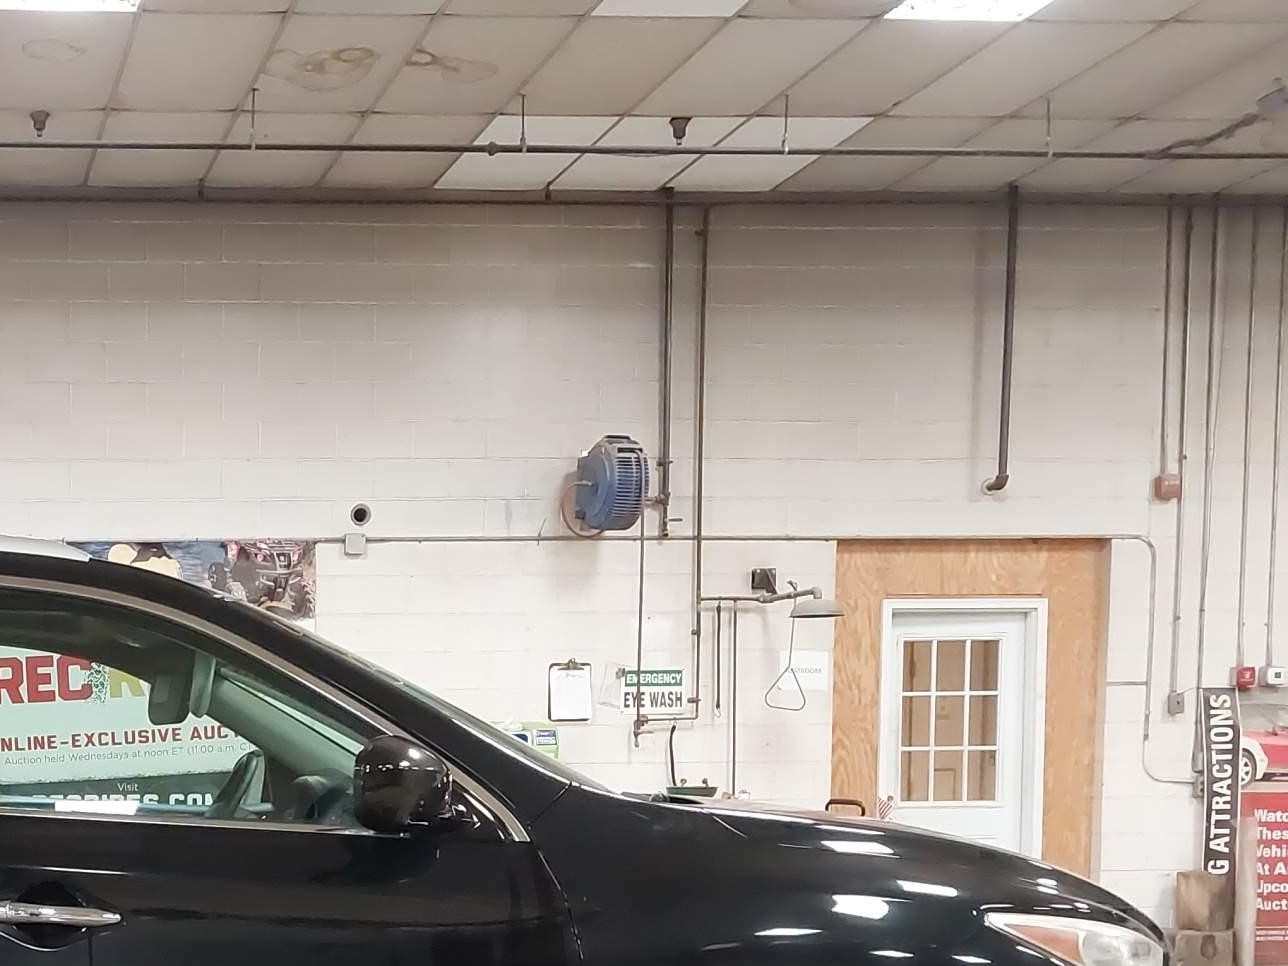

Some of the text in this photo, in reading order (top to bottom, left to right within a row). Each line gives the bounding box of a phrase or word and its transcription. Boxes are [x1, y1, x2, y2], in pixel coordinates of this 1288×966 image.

[624, 691, 683, 708] EYE WASH
[190, 725, 239, 741] AUC
[1209, 694, 1234, 853] ATTRACTIONS
[117, 783, 139, 793] Visit
[1255, 843, 1288, 858] Vehi
